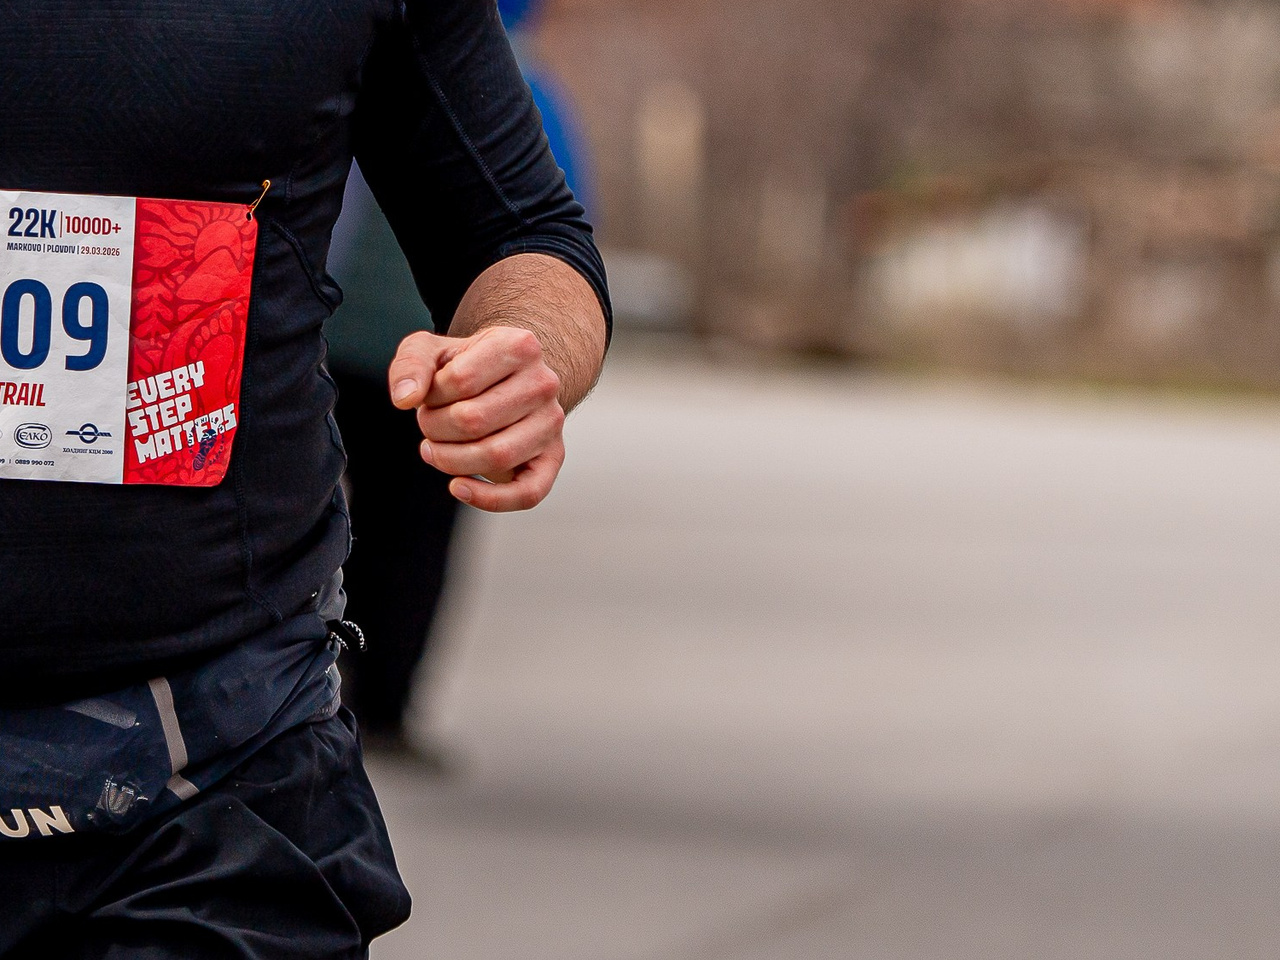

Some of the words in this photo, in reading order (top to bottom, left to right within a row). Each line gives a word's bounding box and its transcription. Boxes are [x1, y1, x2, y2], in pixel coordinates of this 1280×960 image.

[8, 207, 57, 238] 22K
[65, 215, 122, 235] 1000D+
[6, 242, 42, 252] MARKOVO
[47, 244, 76, 254] PLOVDIV
[80, 246, 121, 256] 29.03.2026
[126, 360, 205, 409] EVERY
[128, 393, 192, 437] STEP
[134, 402, 237, 464] MATTERS
